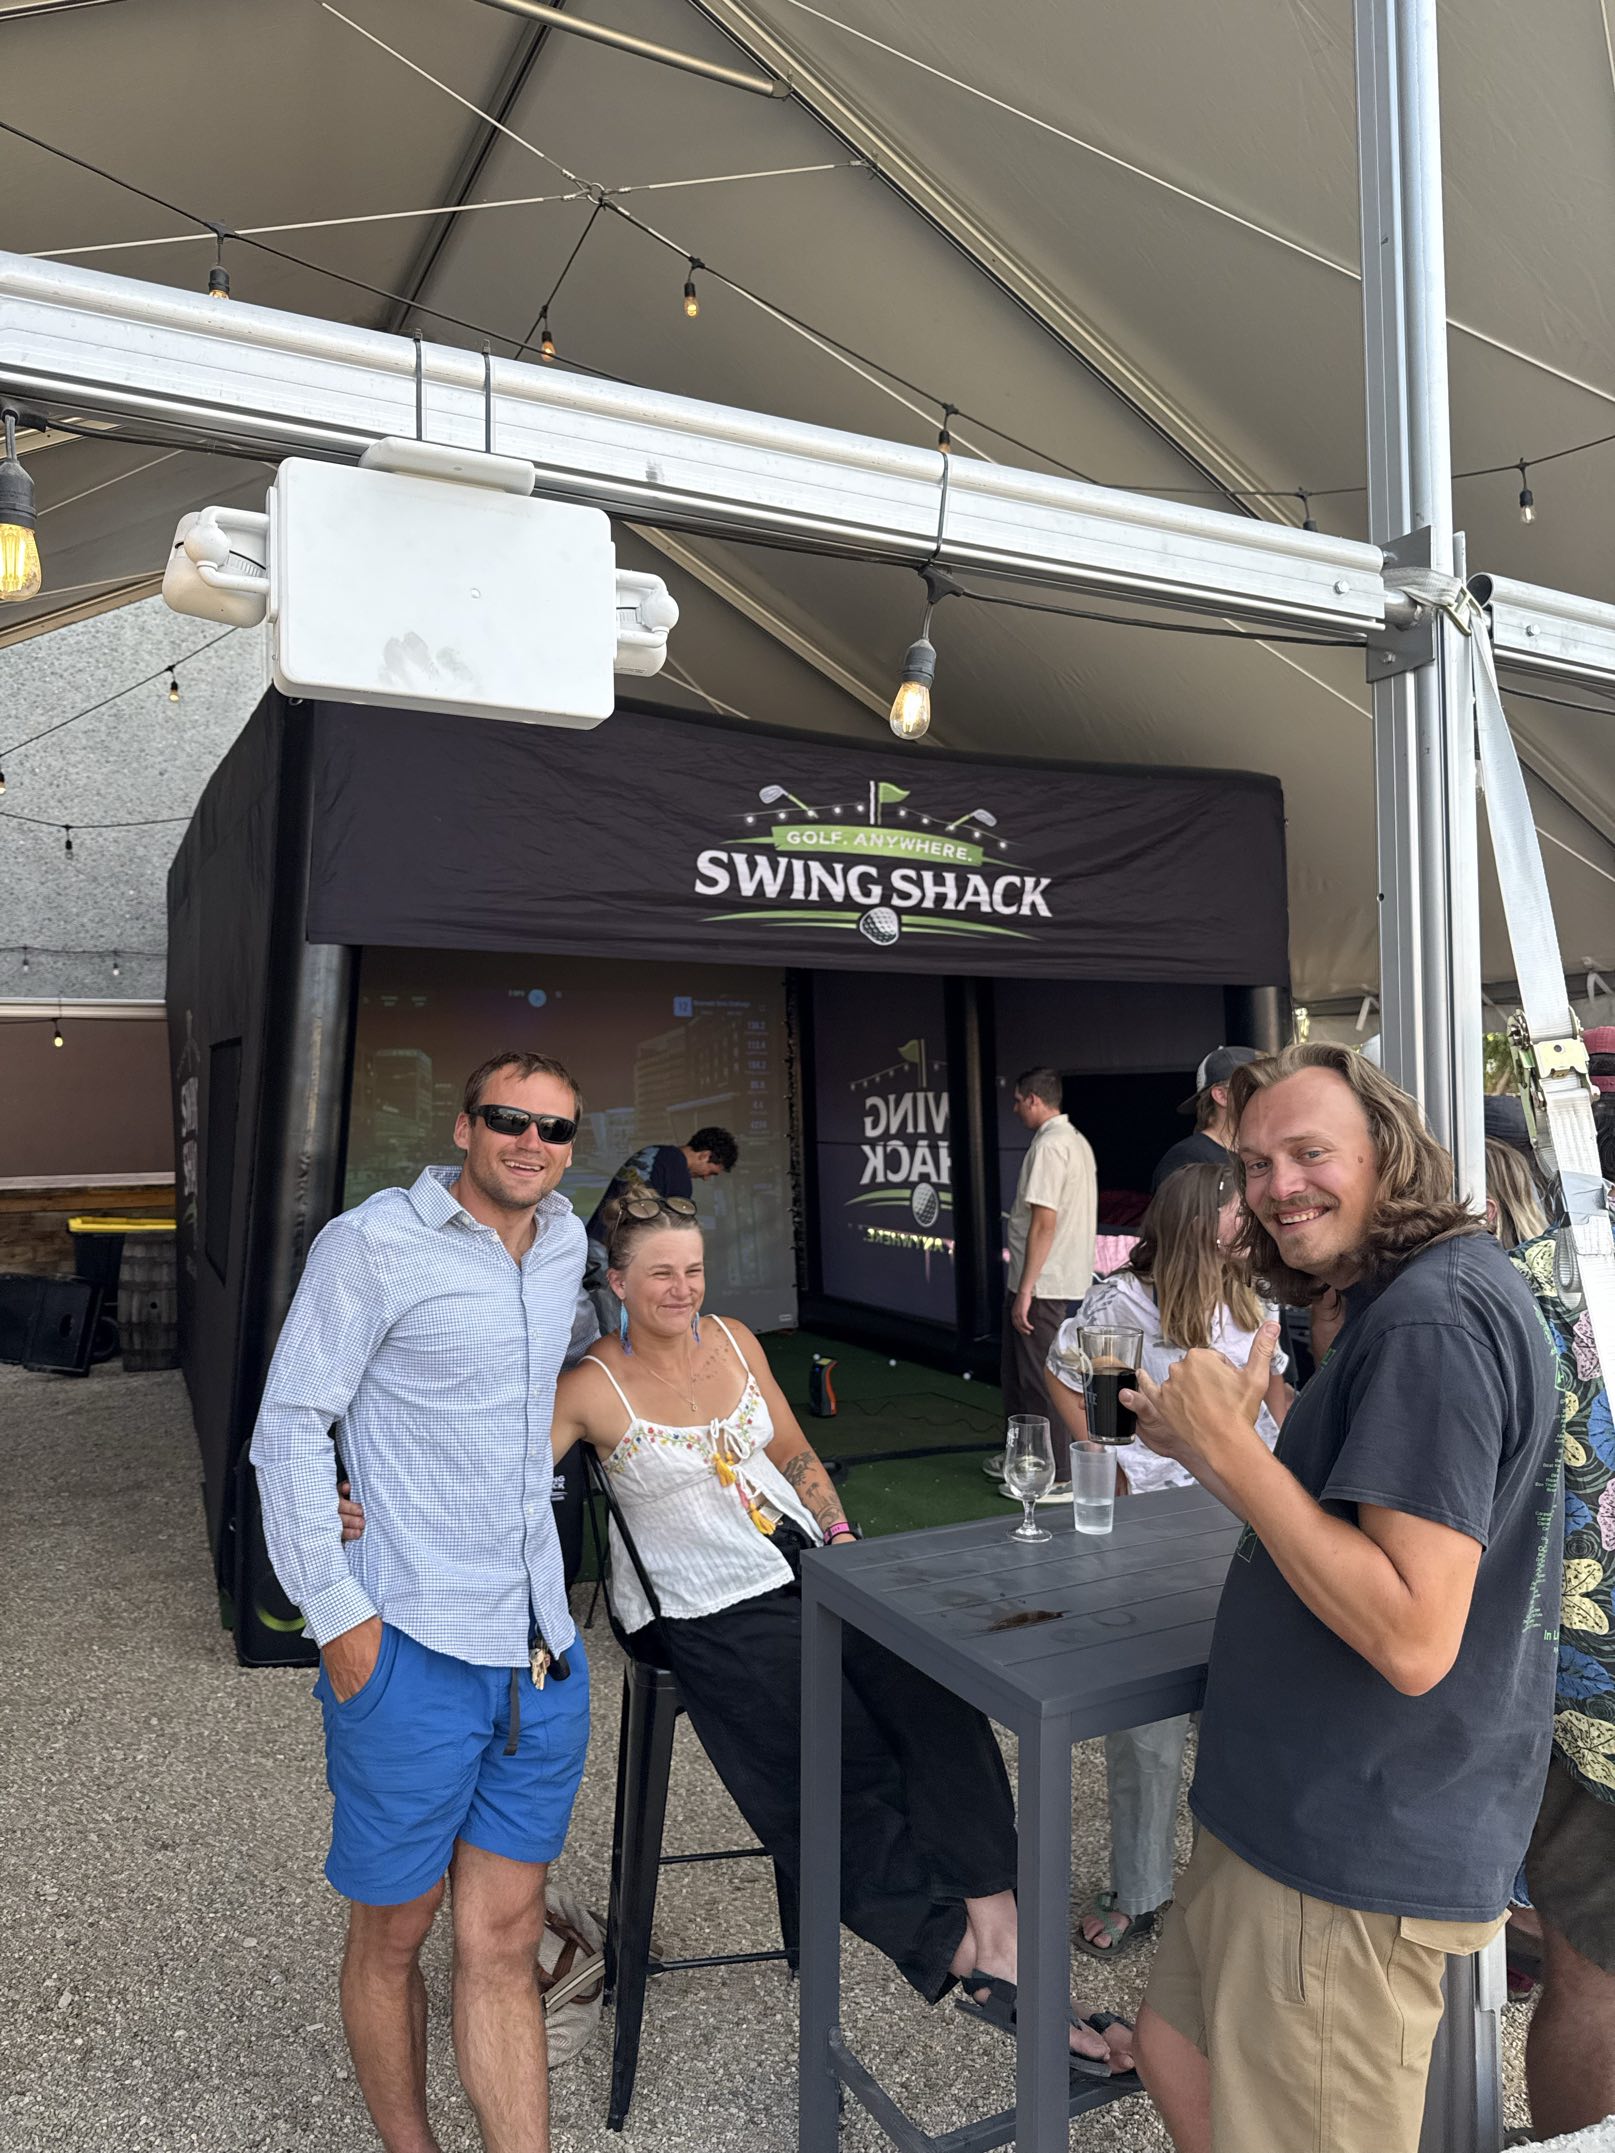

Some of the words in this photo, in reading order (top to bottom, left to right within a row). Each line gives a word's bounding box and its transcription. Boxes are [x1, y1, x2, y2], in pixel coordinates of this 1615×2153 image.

[786, 831, 848, 846] GOLF.
[853, 832, 973, 862] ANYWHERE.
[694, 849, 883, 905] SWING
[890, 867, 1053, 918] SHACK
